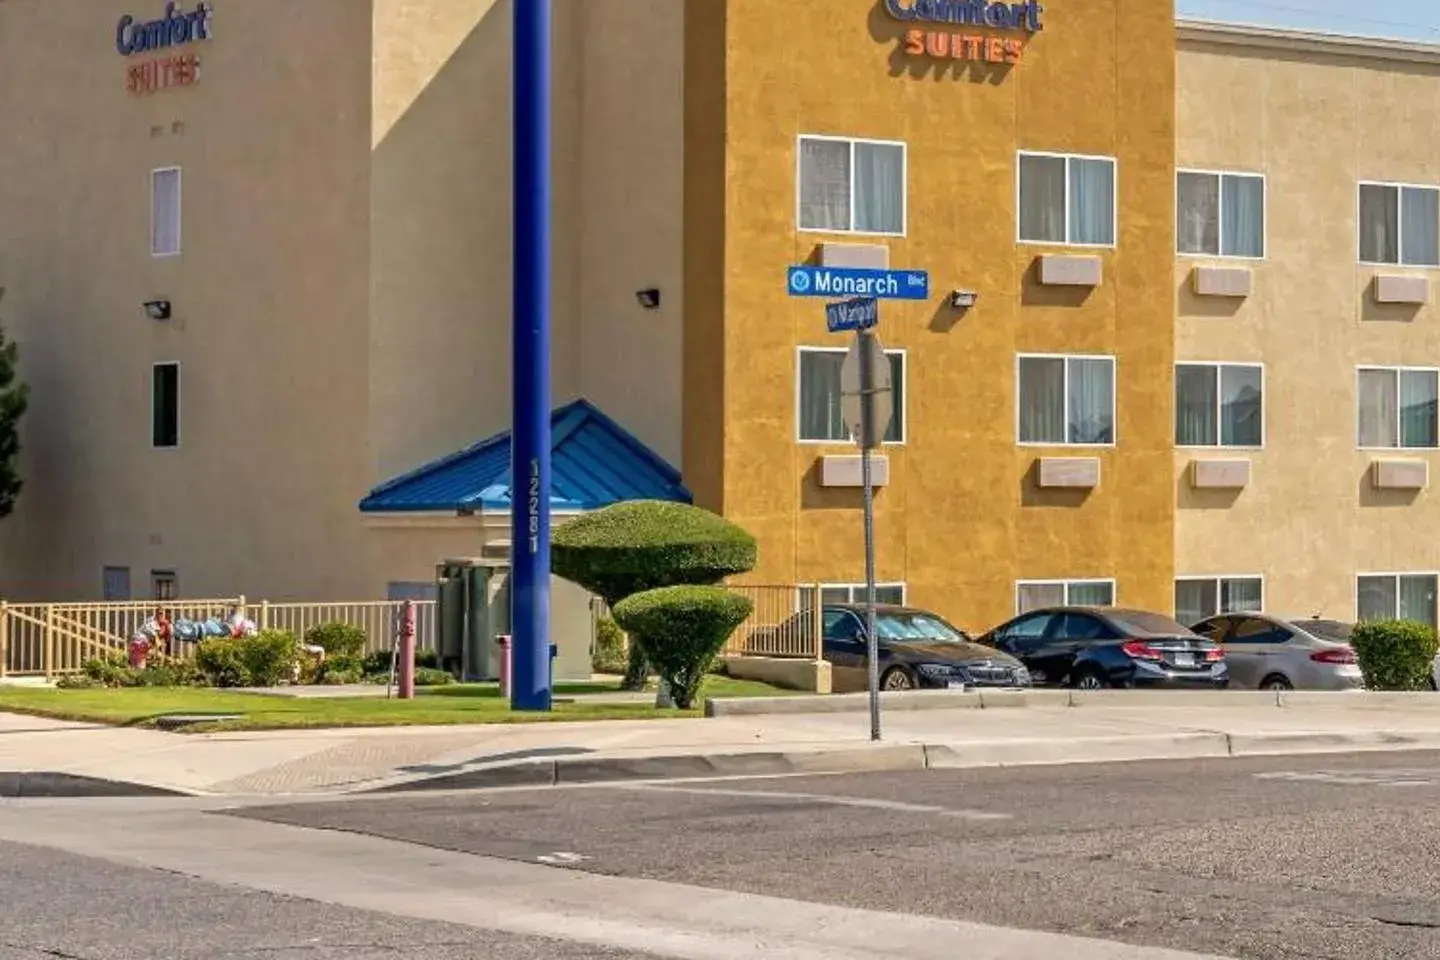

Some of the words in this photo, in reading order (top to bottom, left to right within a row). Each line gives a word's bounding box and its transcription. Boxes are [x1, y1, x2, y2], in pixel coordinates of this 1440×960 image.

[116, 0, 213, 56] Comfort
[904, 28, 1023, 64] SUITES
[814, 270, 898, 294] Monarch
